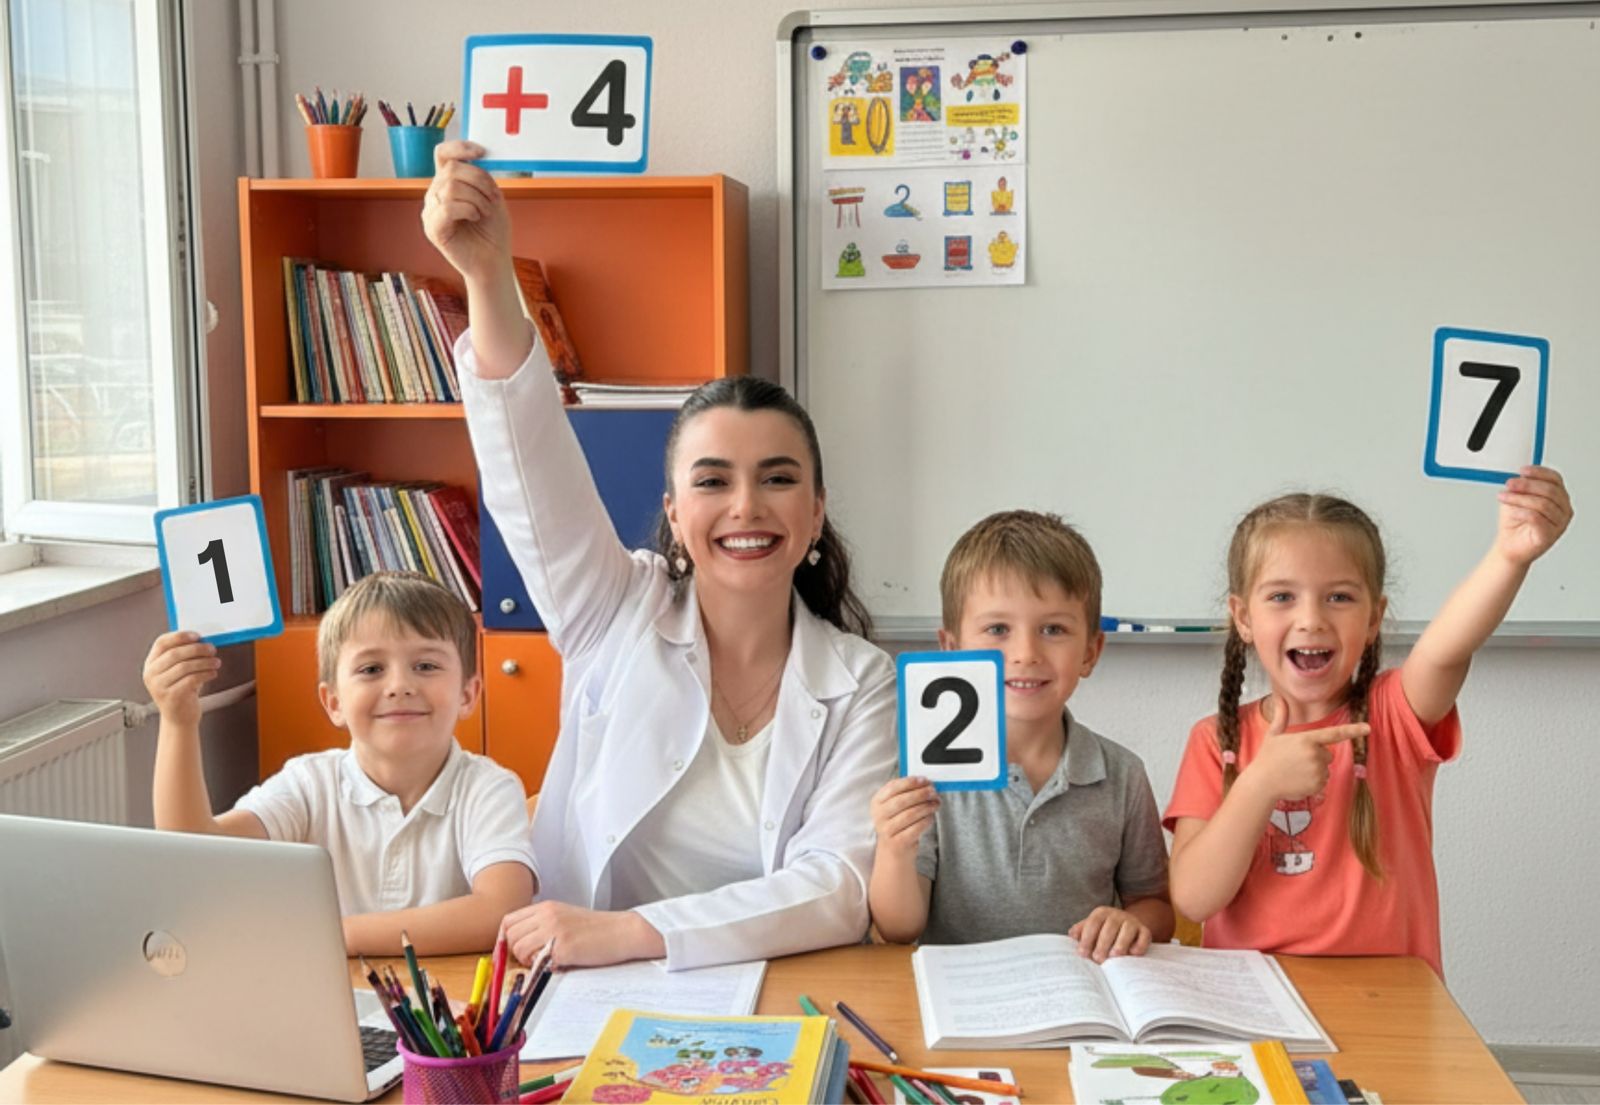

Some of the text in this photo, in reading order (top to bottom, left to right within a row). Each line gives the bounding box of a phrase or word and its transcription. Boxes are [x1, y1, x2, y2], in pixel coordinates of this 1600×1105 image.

[482, 60, 635, 146] + 4
[1459, 361, 1521, 453] 7
[197, 539, 234, 604] 1
[920, 677, 983, 765] 2
